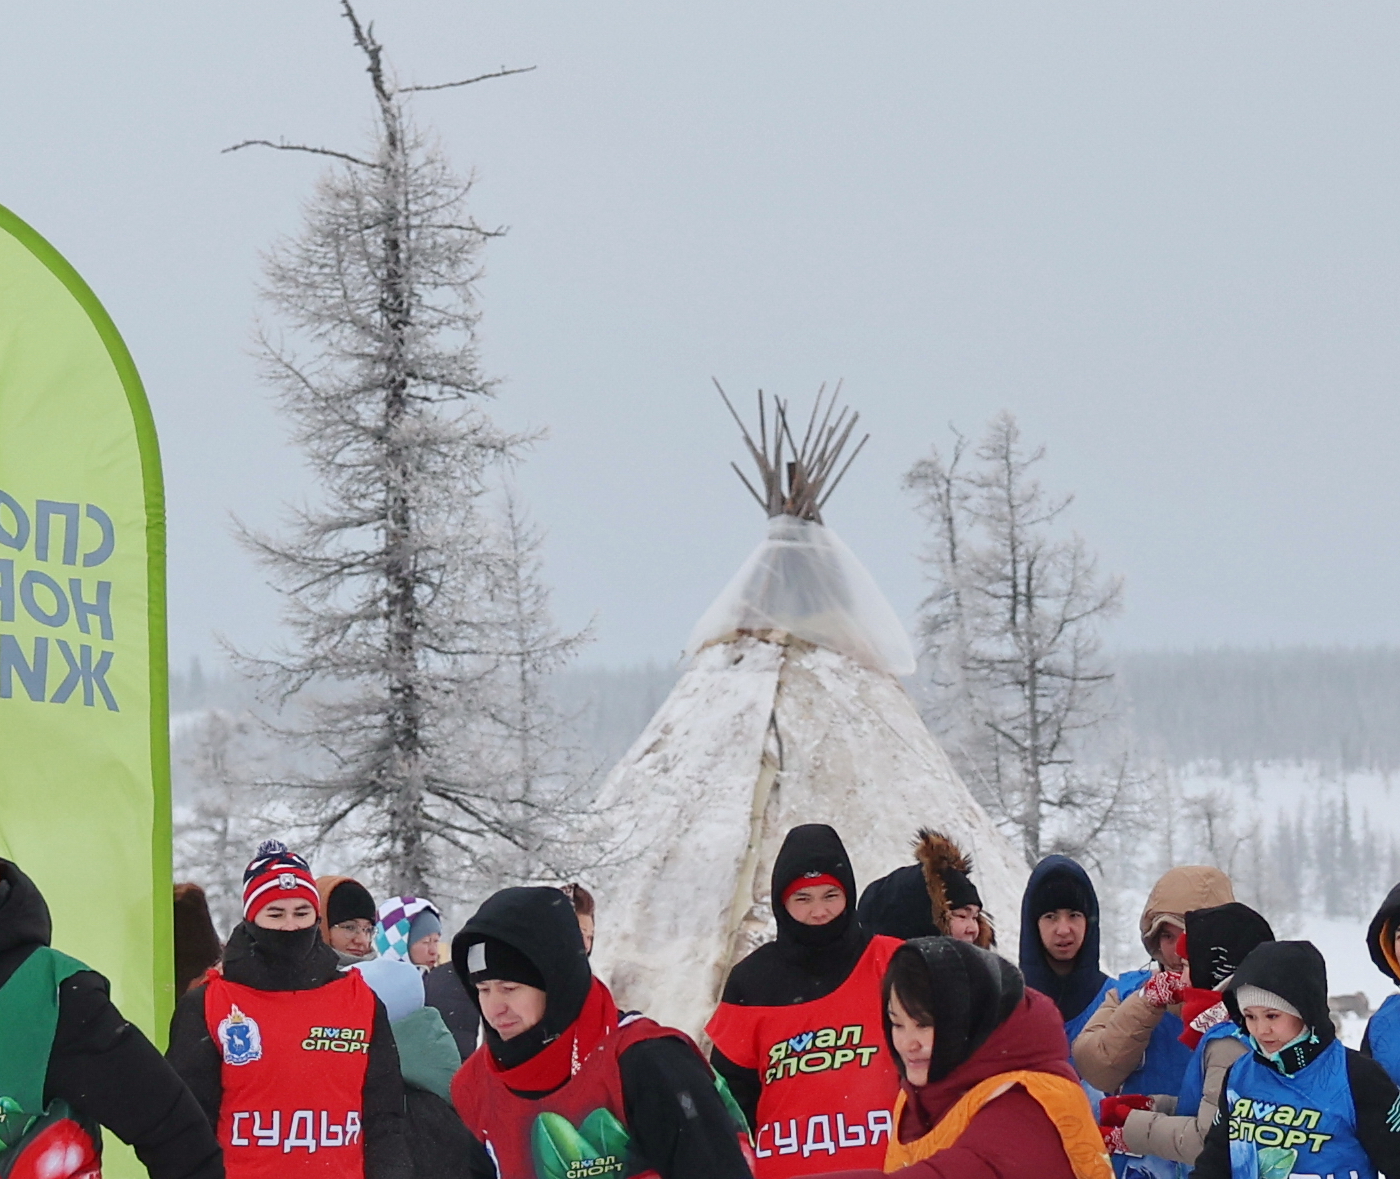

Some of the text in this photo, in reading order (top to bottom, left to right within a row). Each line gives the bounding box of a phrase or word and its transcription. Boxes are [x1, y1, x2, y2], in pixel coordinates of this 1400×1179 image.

[302, 1039, 370, 1054] СПОРТ
[765, 1047, 878, 1085] СПОРТ
[231, 1110, 361, 1154] СУДЬЯ
[755, 1109, 893, 1159] СУДЬЯ
[1228, 1120, 1332, 1153] СПОРТ
[566, 1162, 623, 1179] СПОРТ
